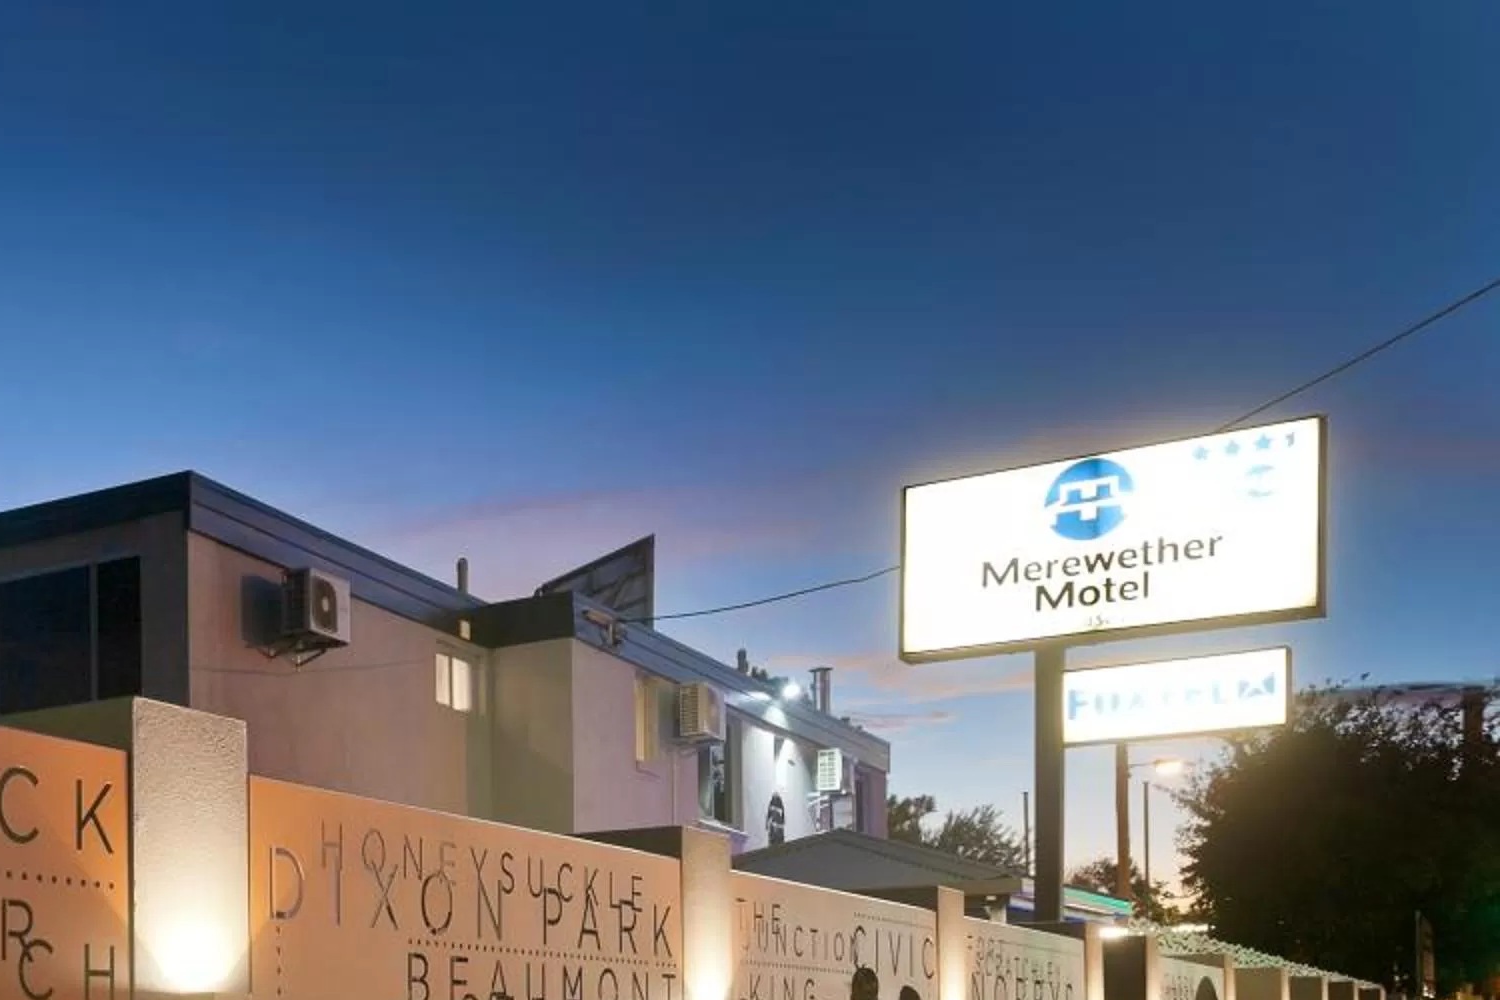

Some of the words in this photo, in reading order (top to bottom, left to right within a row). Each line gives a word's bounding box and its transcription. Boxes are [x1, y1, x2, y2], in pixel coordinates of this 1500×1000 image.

[982, 533, 1223, 588] Merewether
[1035, 571, 1150, 612] Motel
[320, 820, 643, 912] HONEYSUCKLE
[268, 846, 501, 940] DIXON
[542, 886, 674, 957] PARK
[735, 897, 782, 935] THE
[853, 924, 936, 979] CIVIC
